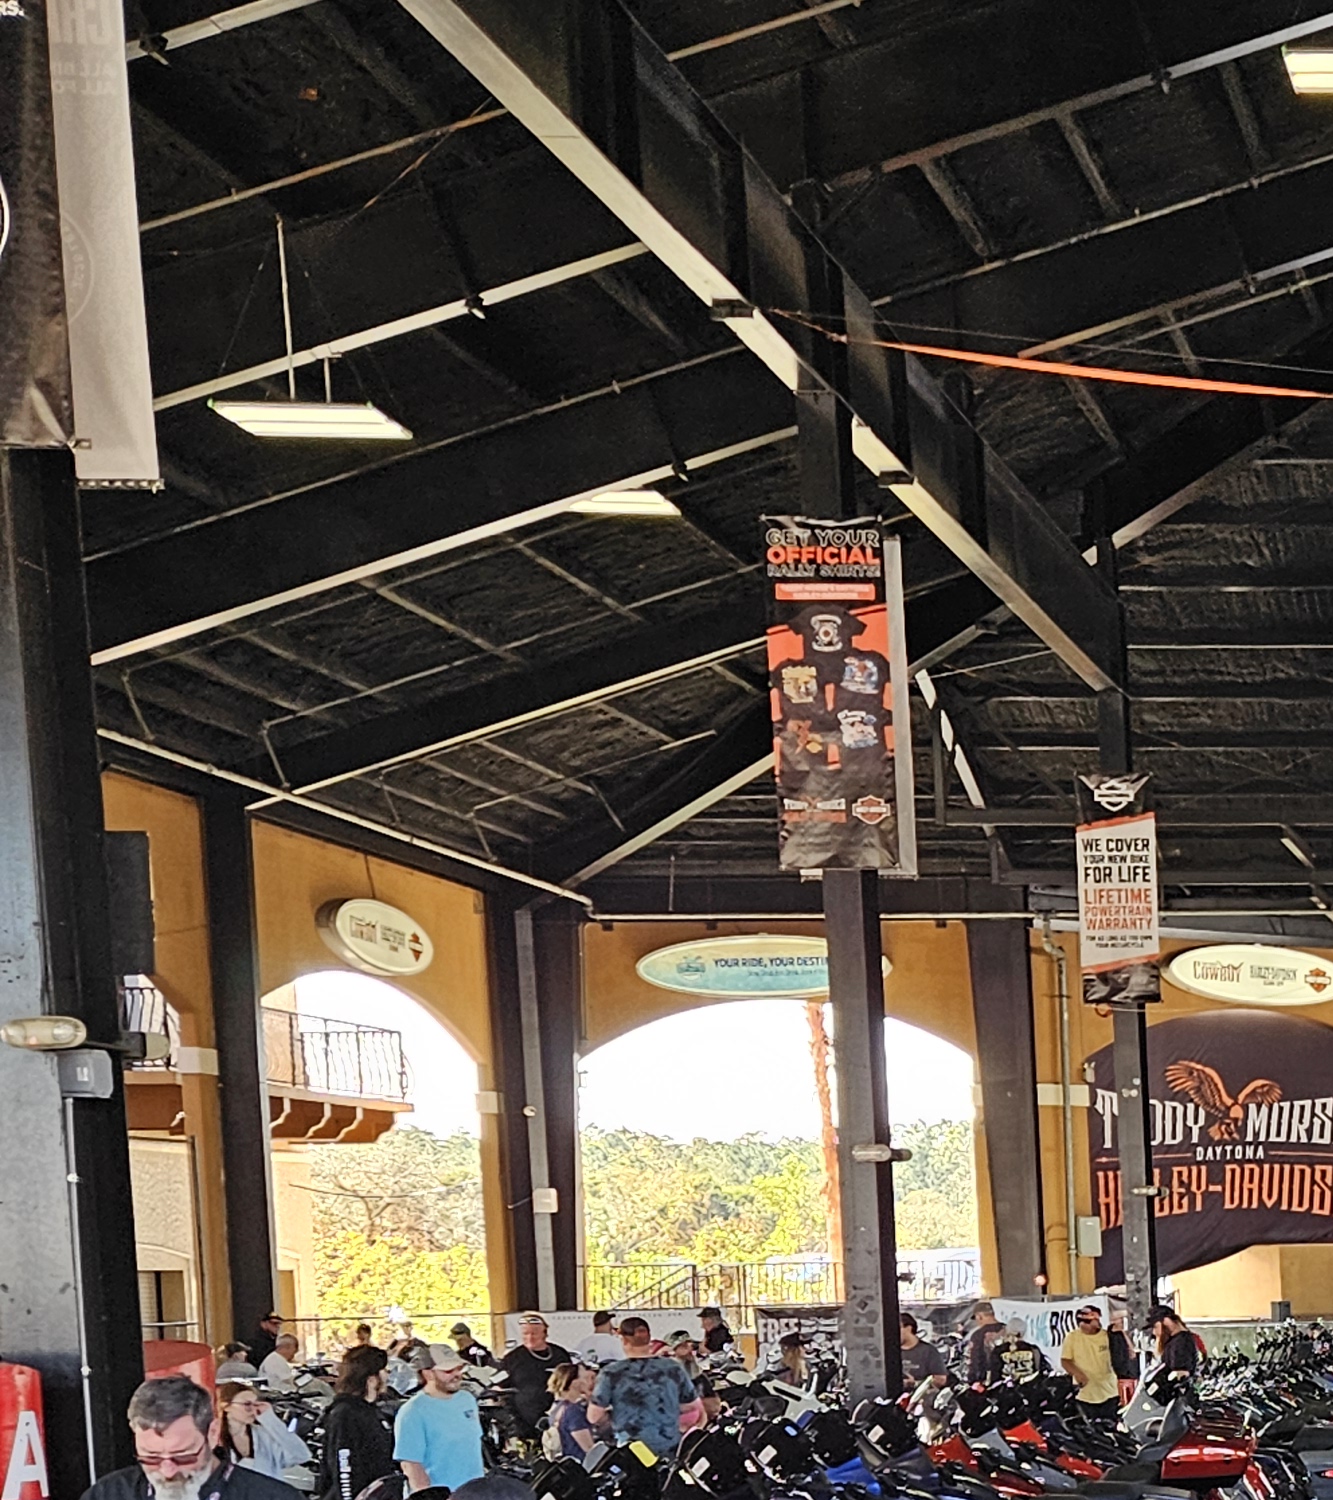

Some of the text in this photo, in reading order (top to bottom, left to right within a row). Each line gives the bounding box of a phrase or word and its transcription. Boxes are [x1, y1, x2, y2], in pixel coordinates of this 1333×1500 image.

[766, 528, 880, 547] GET YOUR
[767, 546, 880, 564] OFFICIAL
[767, 564, 816, 577] RALLY
[1081, 838, 1150, 853] WE COVER
[1083, 855, 1106, 865] YOUR
[1107, 854, 1127, 864] NEW
[1084, 866, 1151, 883] FOR LIFE
[1084, 888, 1152, 905] LIFETIME
[1084, 906, 1153, 917] POWERTRAIN
[1085, 917, 1153, 931] WARRANTY
[712, 957, 740, 968] YOUR
[741, 957, 768, 969] RIDE,
[769, 957, 794, 967] YOUR
[1193, 961, 1244, 983] COWBOY
[1094, 1089, 1207, 1149] TDDY
[1195, 1145, 1265, 1161] DAYTONA
[757, 1318, 799, 1343] FREE
